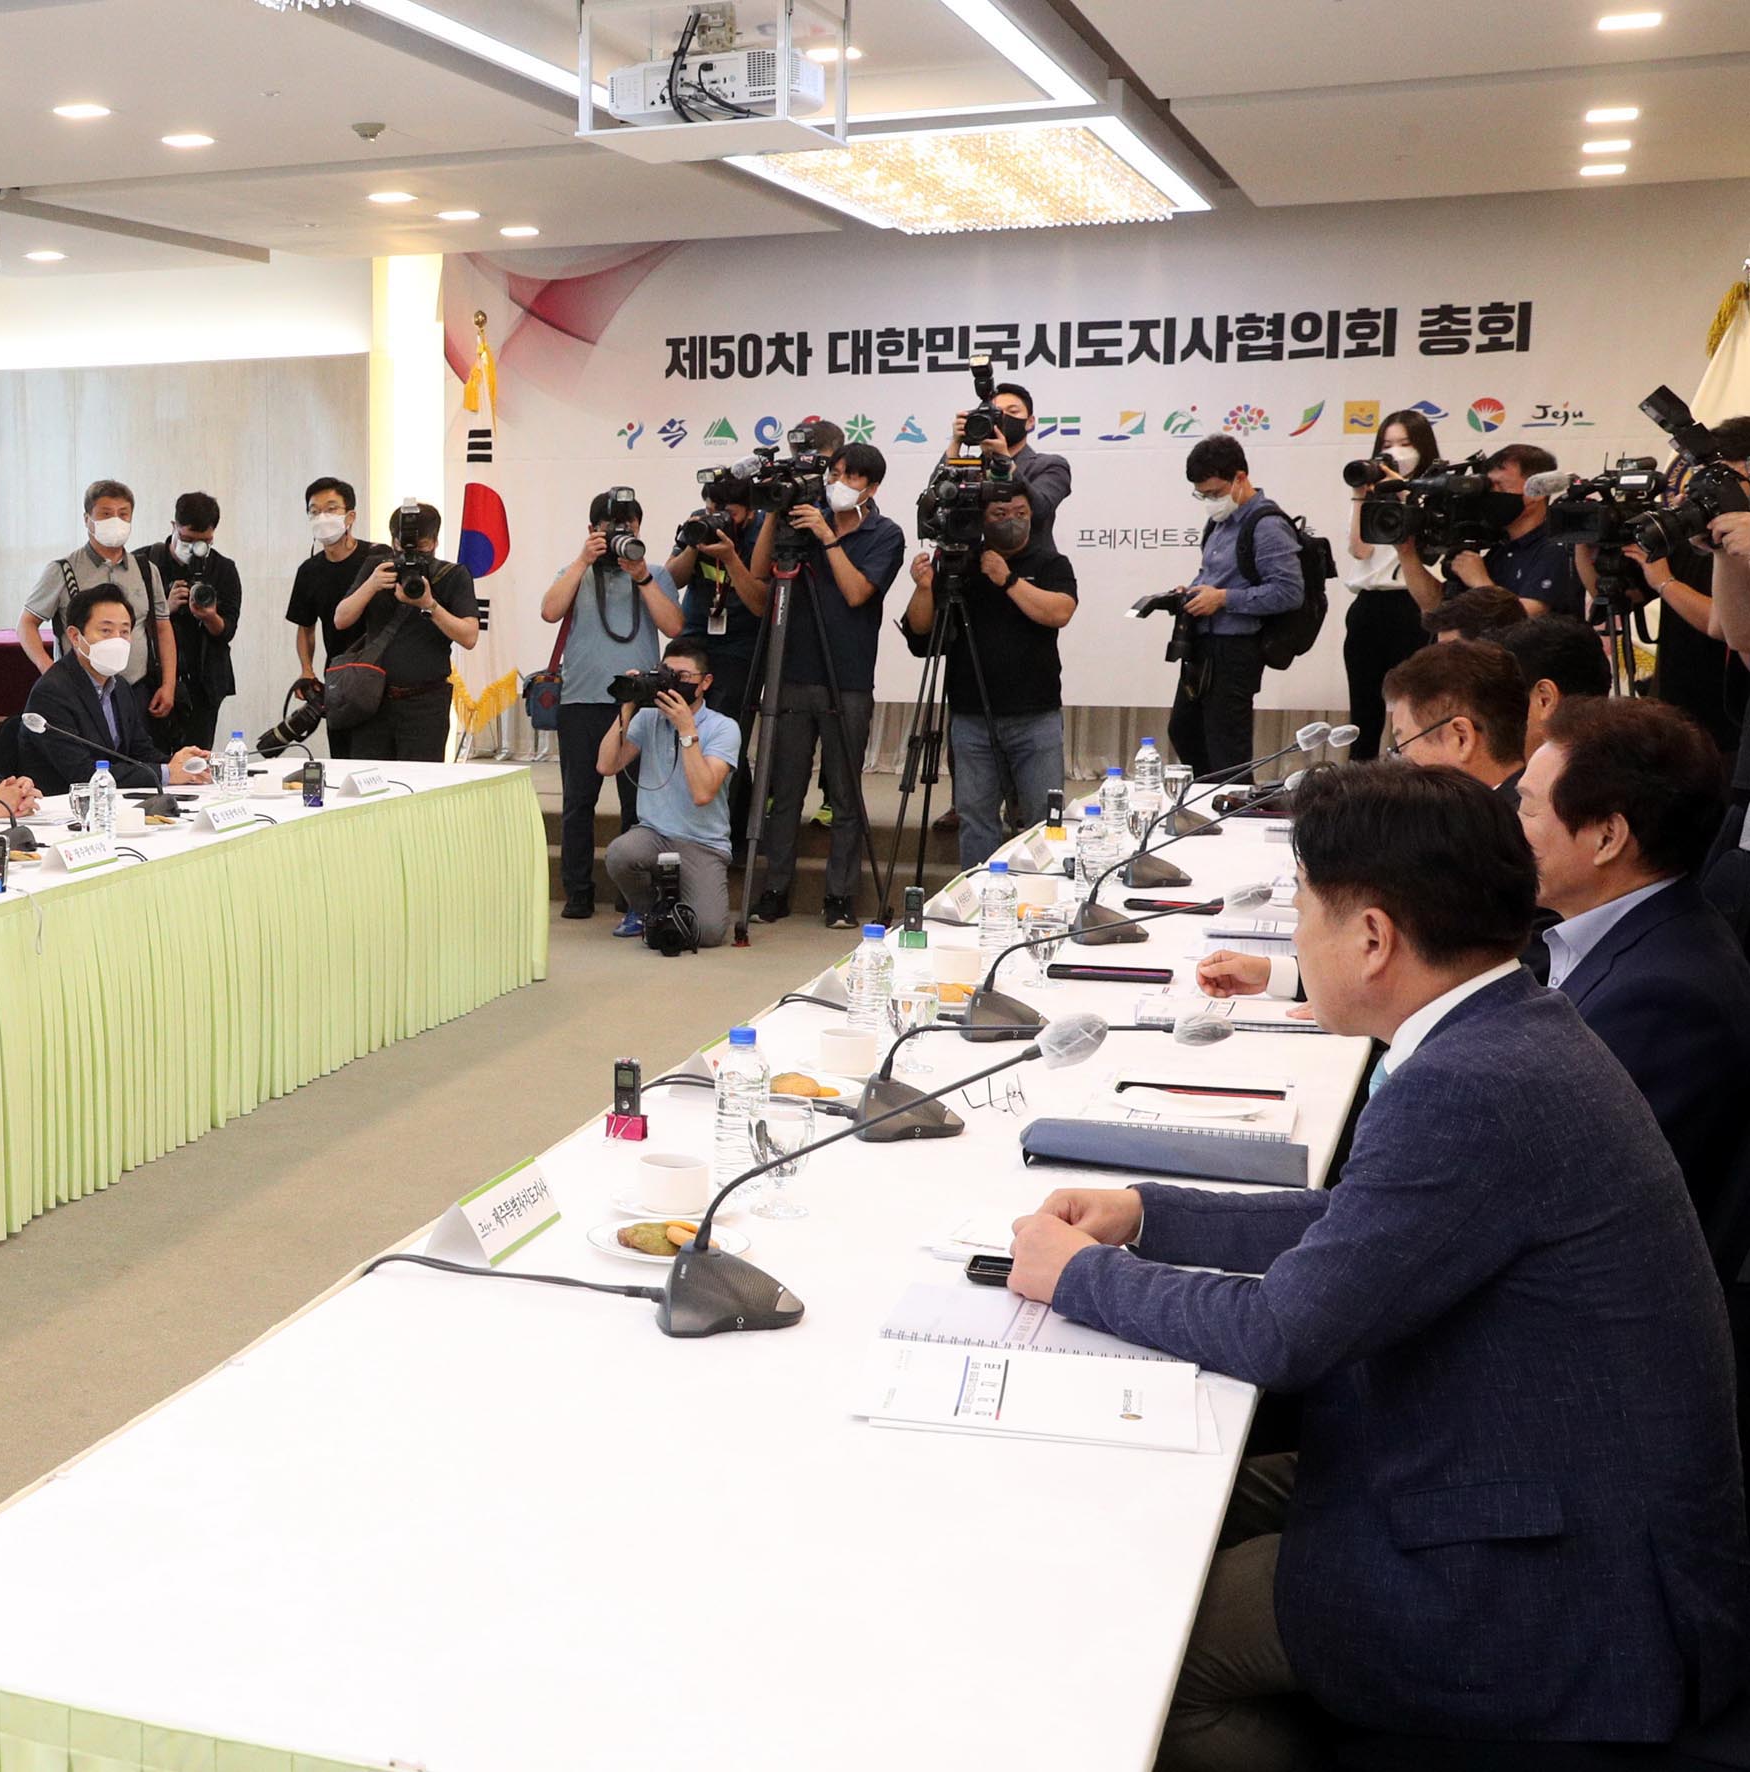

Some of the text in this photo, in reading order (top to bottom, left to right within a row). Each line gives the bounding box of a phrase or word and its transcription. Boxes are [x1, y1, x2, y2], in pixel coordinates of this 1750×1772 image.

[664, 301, 1533, 380] 제50차 대한민국시도지사협의회 총회
[1531, 401, 1584, 427] Jeju
[1076, 527, 1202, 549] 프레지던트호
